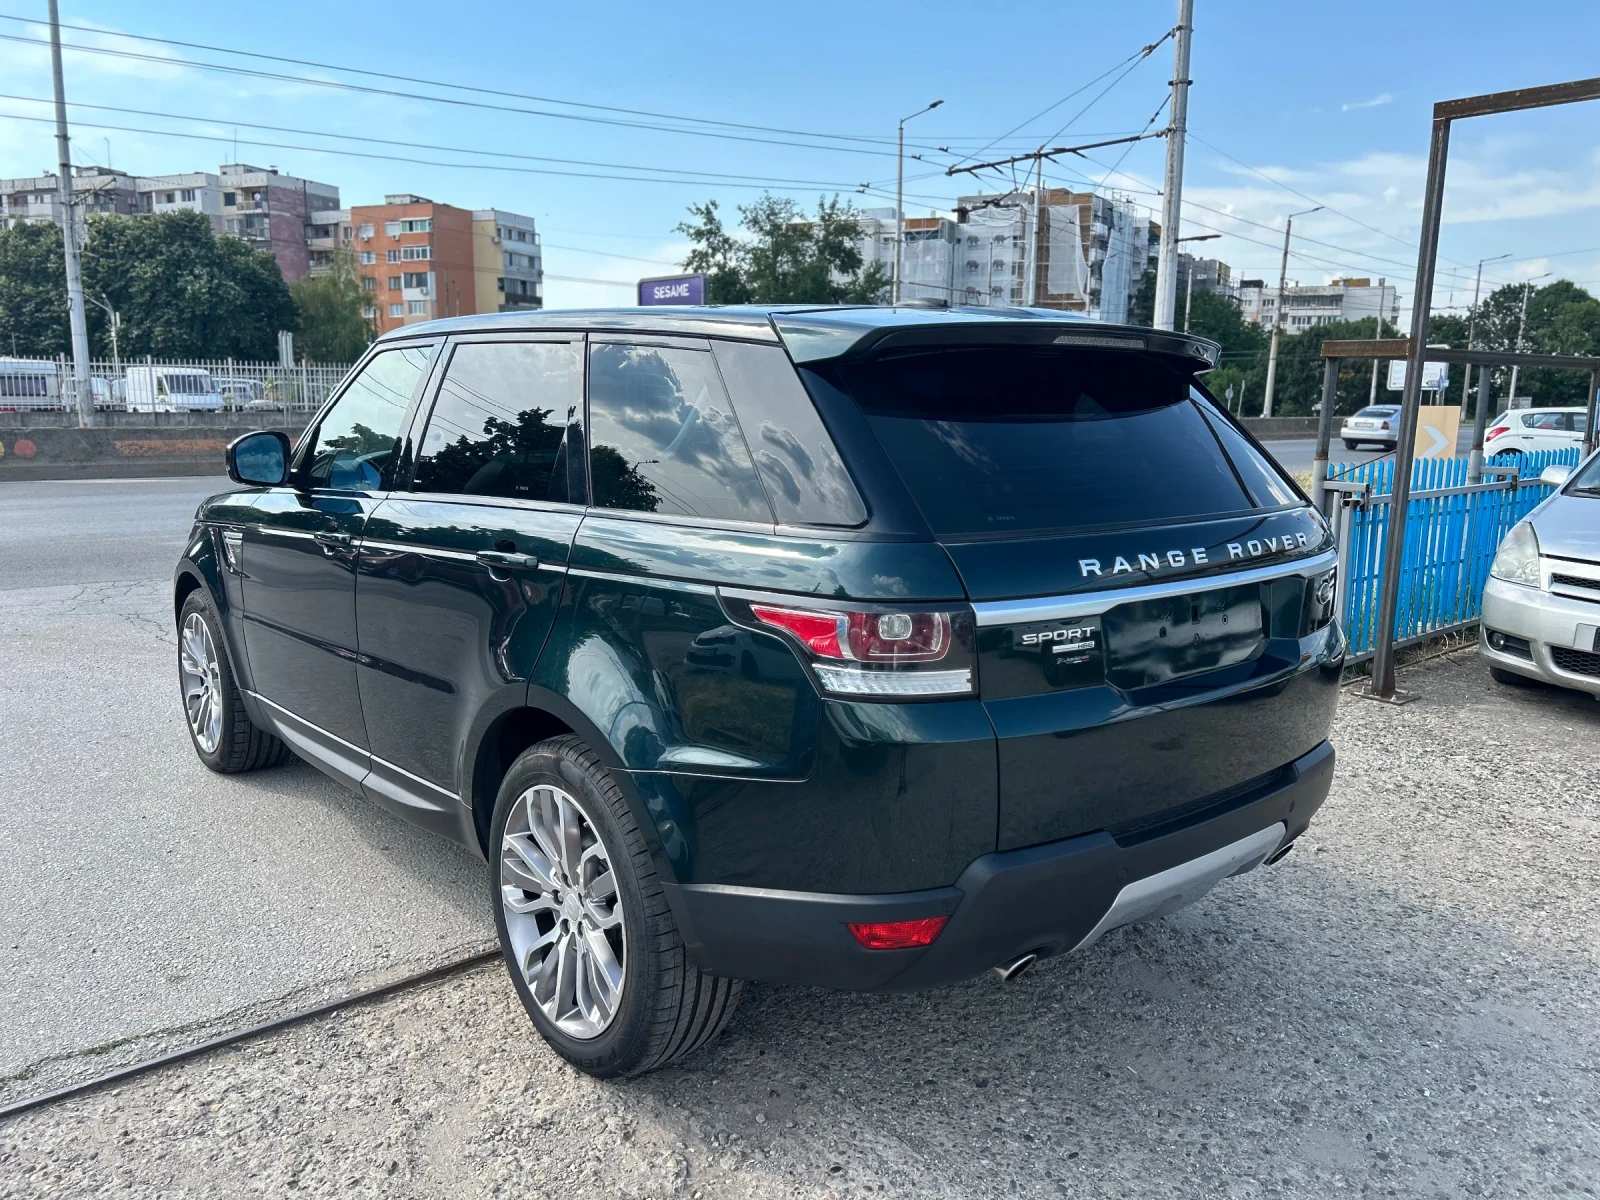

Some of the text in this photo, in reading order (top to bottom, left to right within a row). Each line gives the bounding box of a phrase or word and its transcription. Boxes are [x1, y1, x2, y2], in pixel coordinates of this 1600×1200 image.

[654, 284, 689, 298] SESAME
[1079, 532, 1308, 577] RANGE ROVER
[1022, 627, 1095, 644] SPORT
